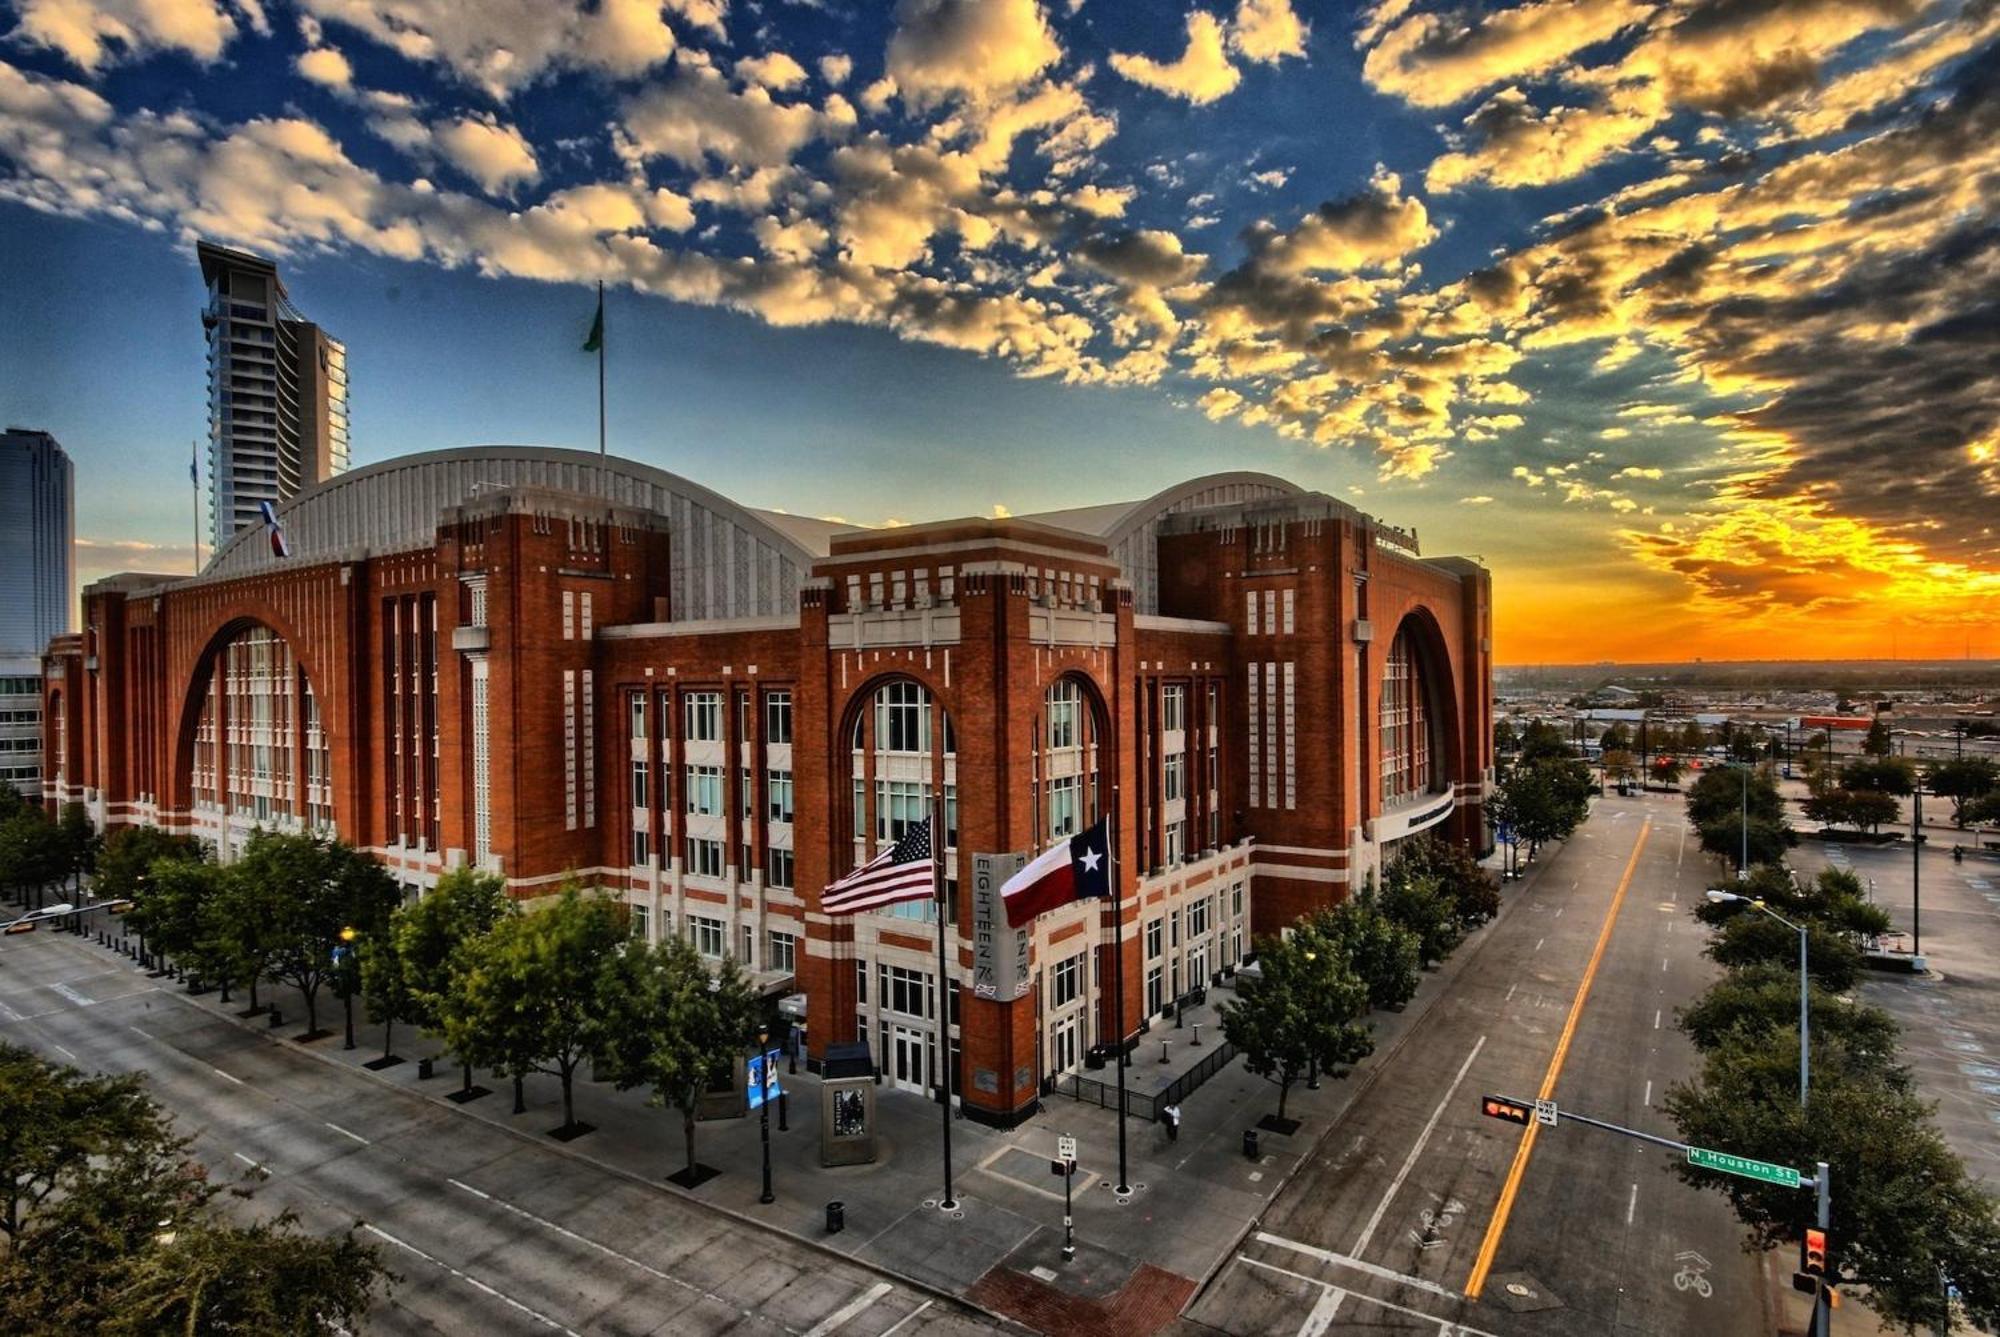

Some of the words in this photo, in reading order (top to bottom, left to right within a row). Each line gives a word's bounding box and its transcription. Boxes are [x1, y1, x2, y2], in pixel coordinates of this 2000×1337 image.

[977, 858, 991, 959] EIGHTEEN
[977, 965, 993, 981] 76
[1538, 1101, 1555, 1109] ONE
[1538, 1107, 1555, 1116] WAY
[1708, 1153, 1769, 1174] Houston
[1775, 1167, 1797, 1181] St.
